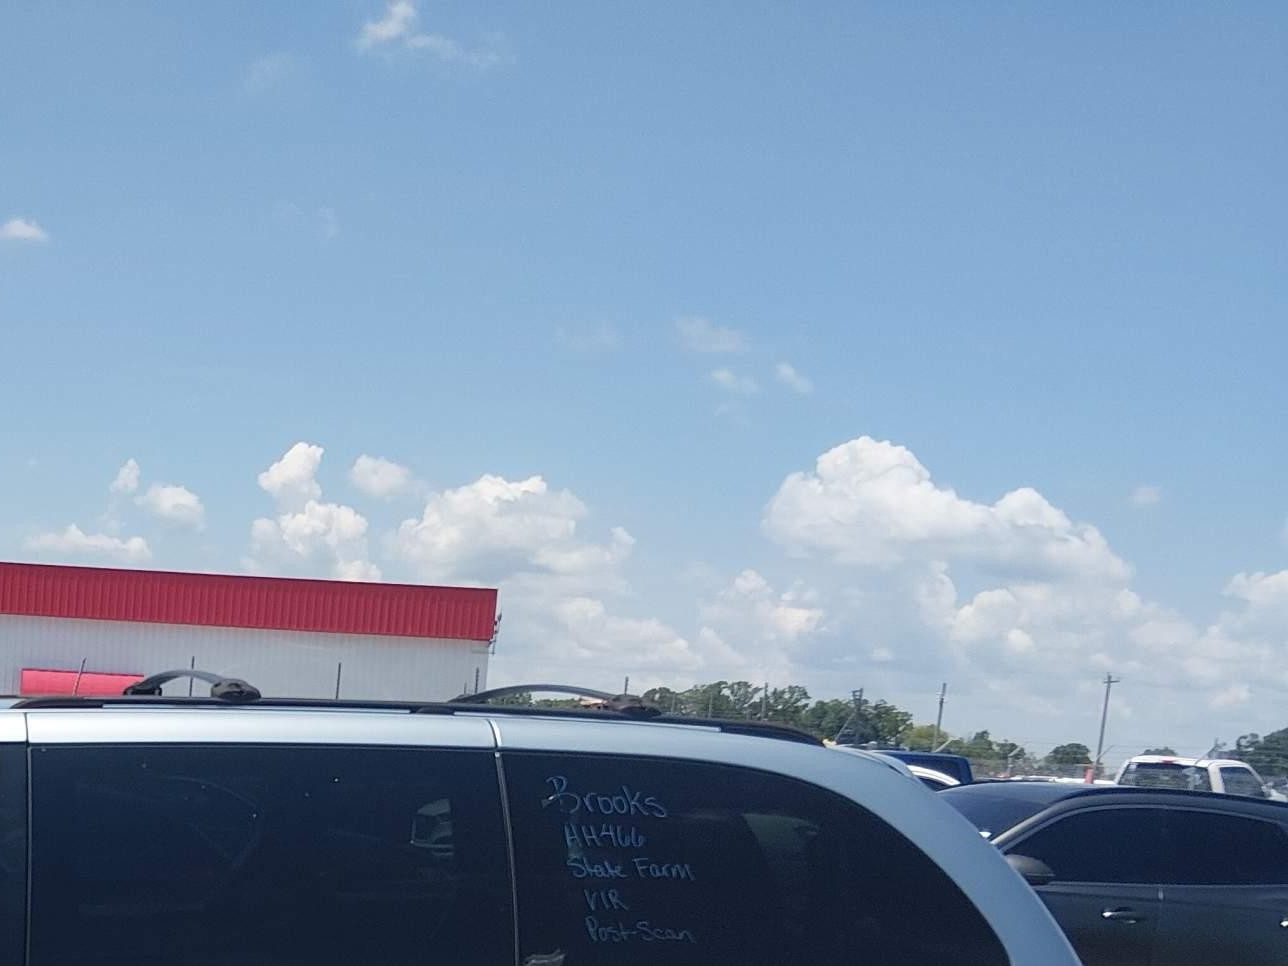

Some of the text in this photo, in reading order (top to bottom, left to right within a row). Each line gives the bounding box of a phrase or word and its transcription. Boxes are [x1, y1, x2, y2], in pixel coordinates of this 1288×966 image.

[546, 775, 668, 818] Brooks
[566, 856, 696, 881] State Farm
